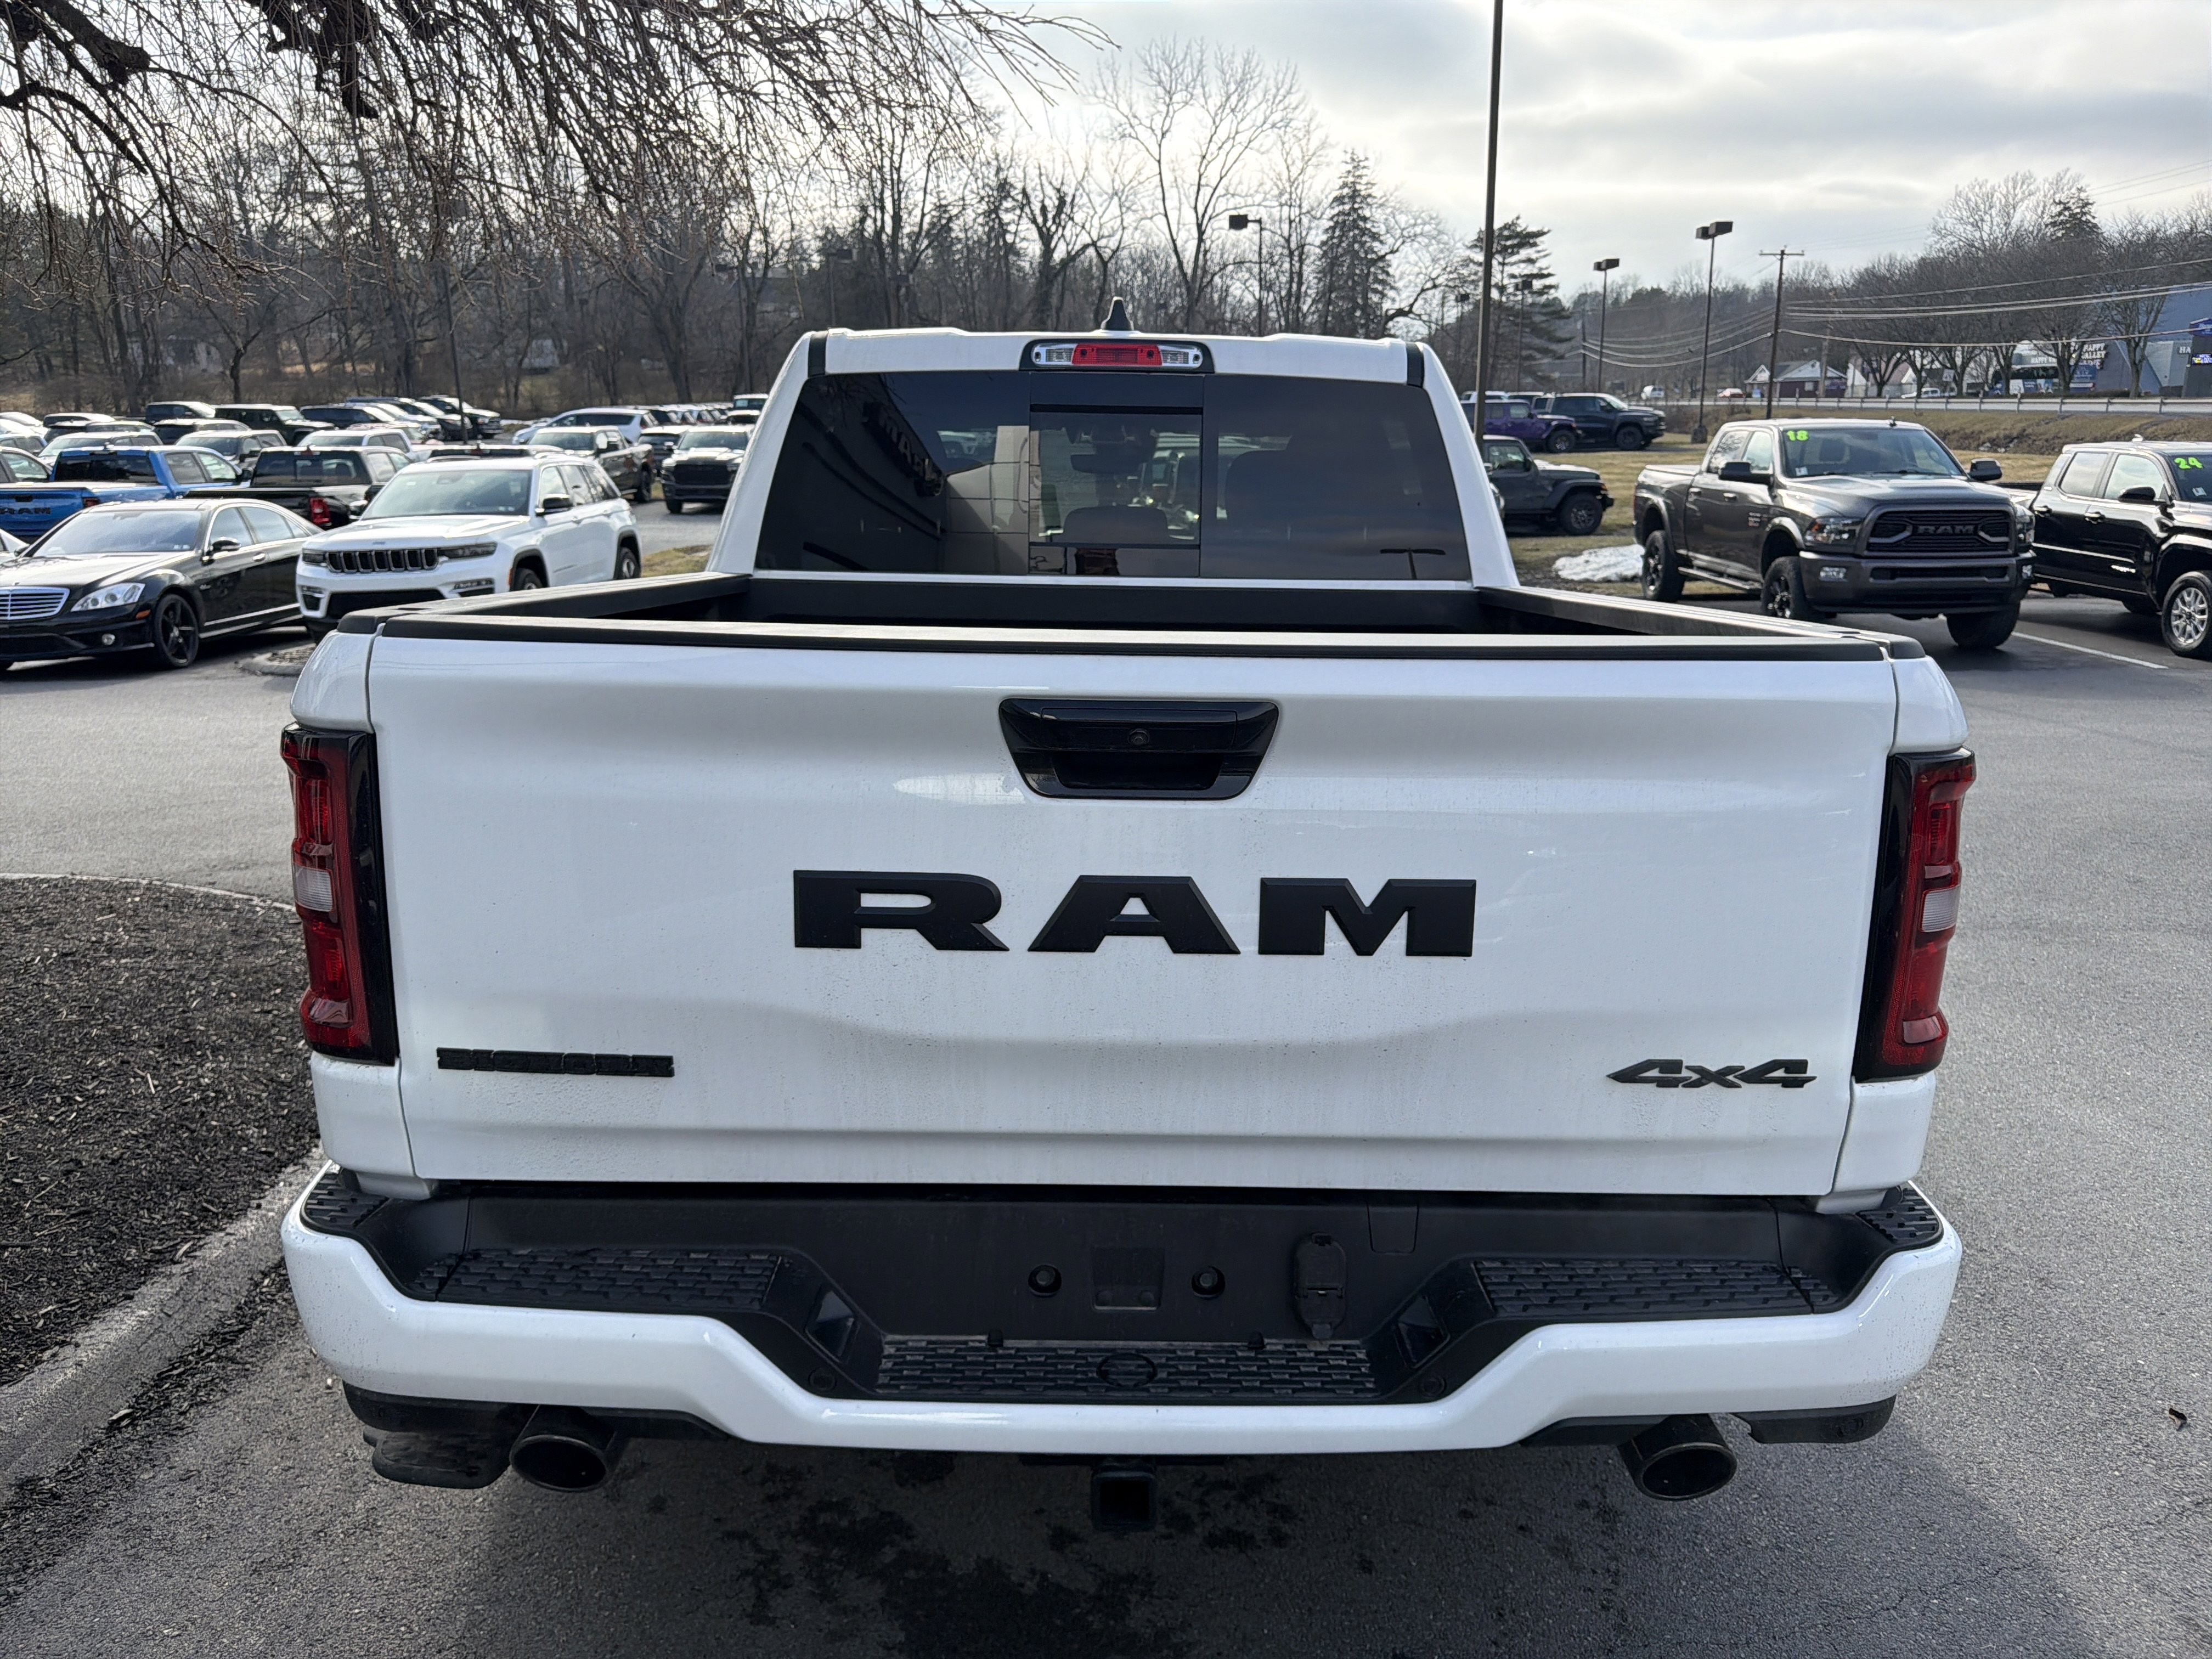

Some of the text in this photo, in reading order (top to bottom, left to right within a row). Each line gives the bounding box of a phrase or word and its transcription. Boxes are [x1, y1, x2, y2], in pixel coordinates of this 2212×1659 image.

[2081, 351, 2106, 359] ALLEY
[1786, 430, 1809, 441] 18
[2174, 457, 2203, 469] 24
[1917, 526, 1974, 534] RAM
[793, 869, 1477, 957] RAM
[1606, 1059, 1818, 1088] 4x4
